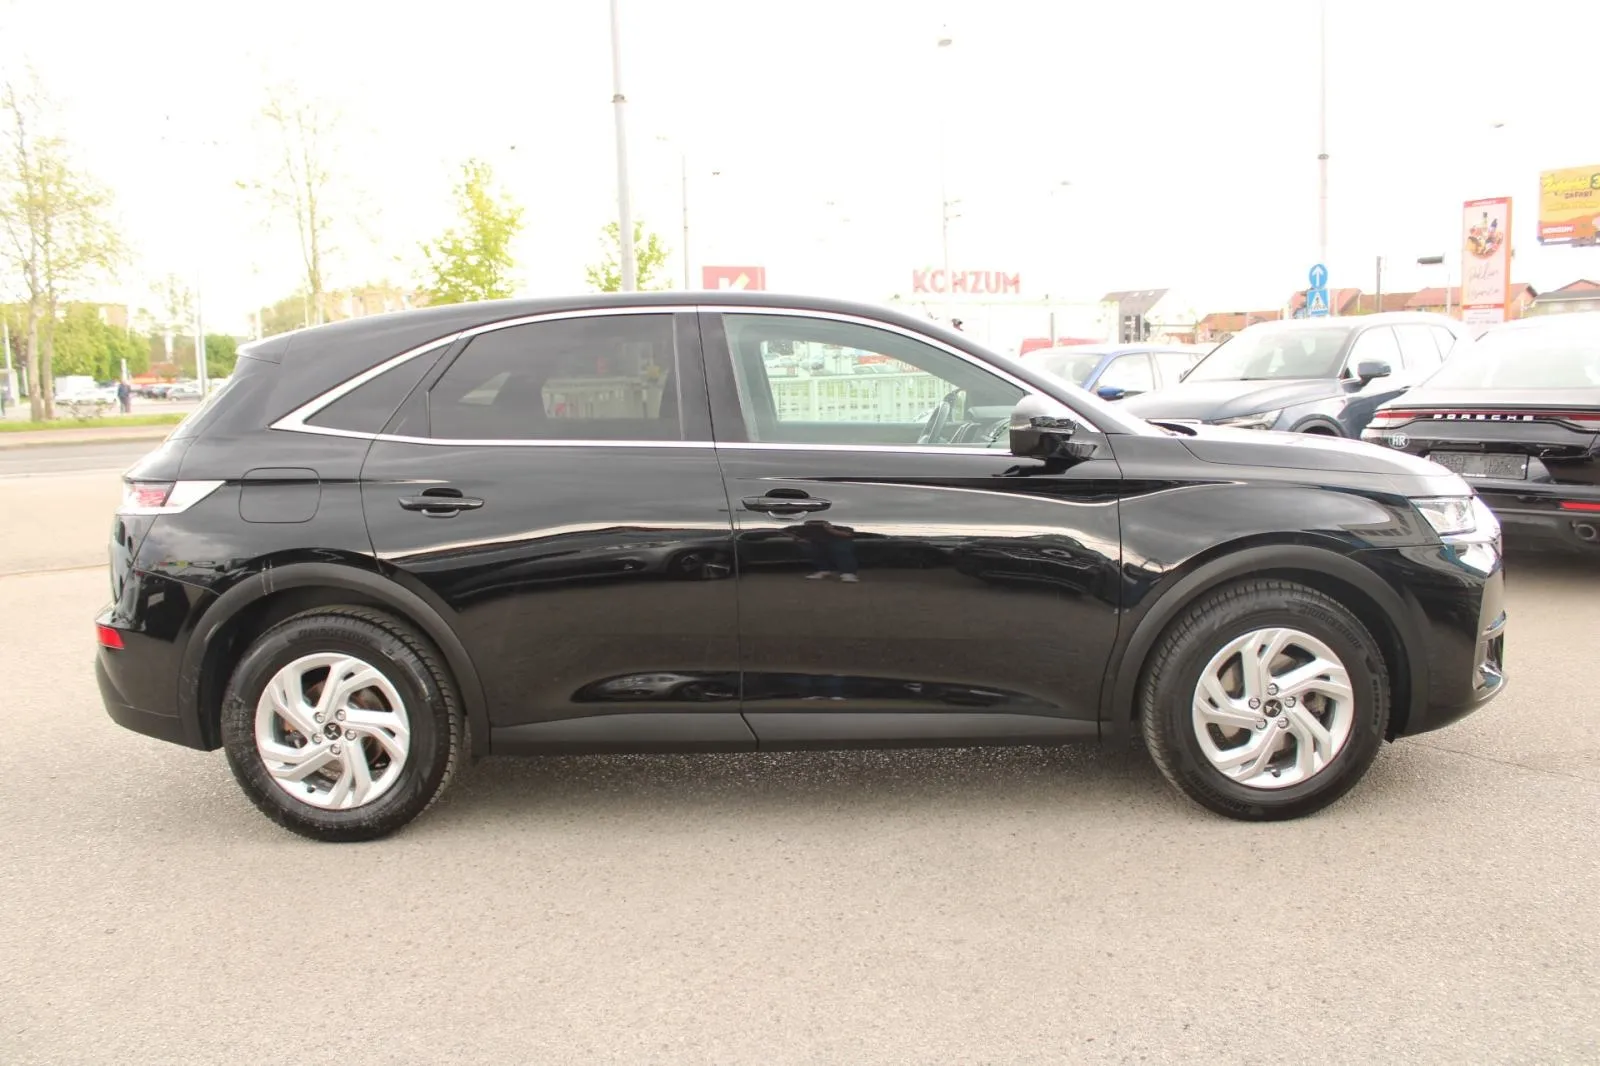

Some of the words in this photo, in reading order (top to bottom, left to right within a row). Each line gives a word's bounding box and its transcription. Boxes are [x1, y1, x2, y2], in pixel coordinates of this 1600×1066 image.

[912, 267, 1020, 294] KONZUM
[1433, 413, 1534, 421] PORSCHE
[1391, 435, 1406, 446] HR
